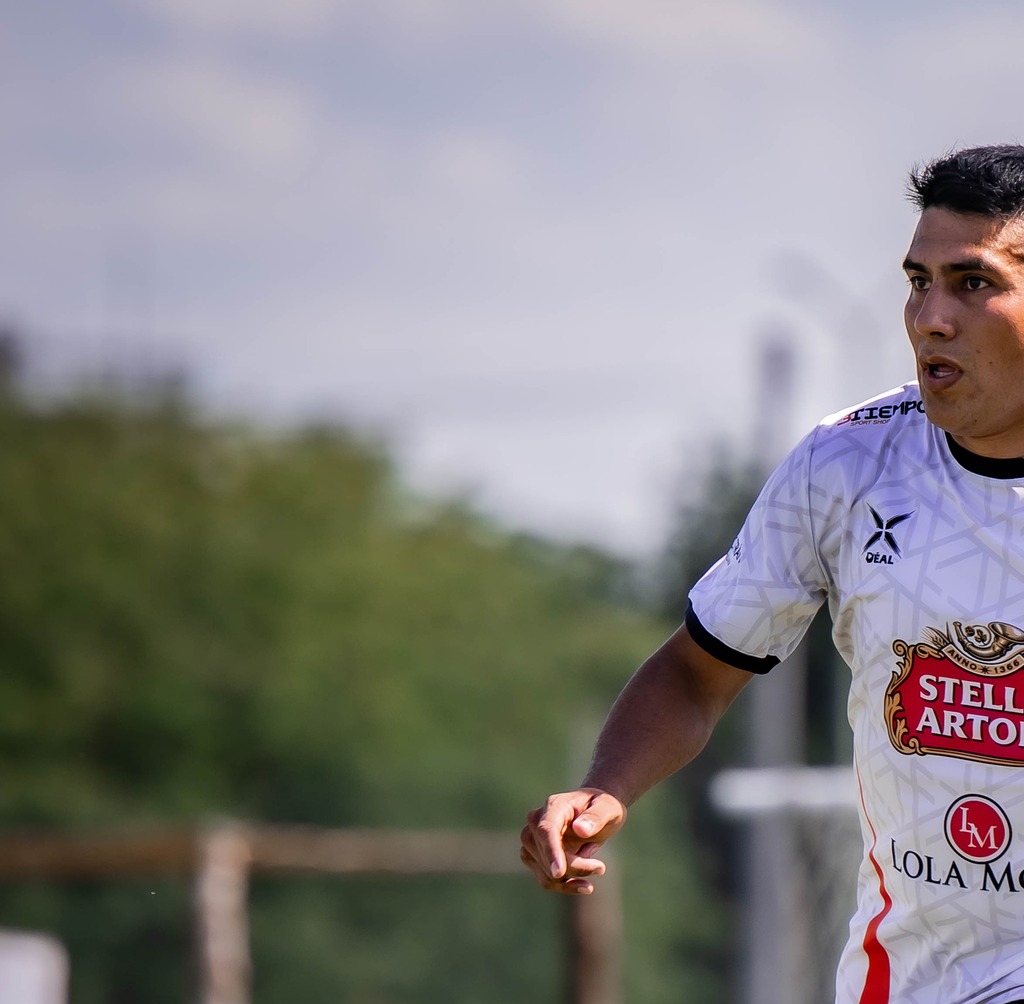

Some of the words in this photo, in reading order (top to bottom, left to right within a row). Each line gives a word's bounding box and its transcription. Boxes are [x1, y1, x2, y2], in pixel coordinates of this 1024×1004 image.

[948, 649, 978, 671] ANNO
[994, 660, 1020, 674] 1366
[891, 837, 968, 889] LOLA
